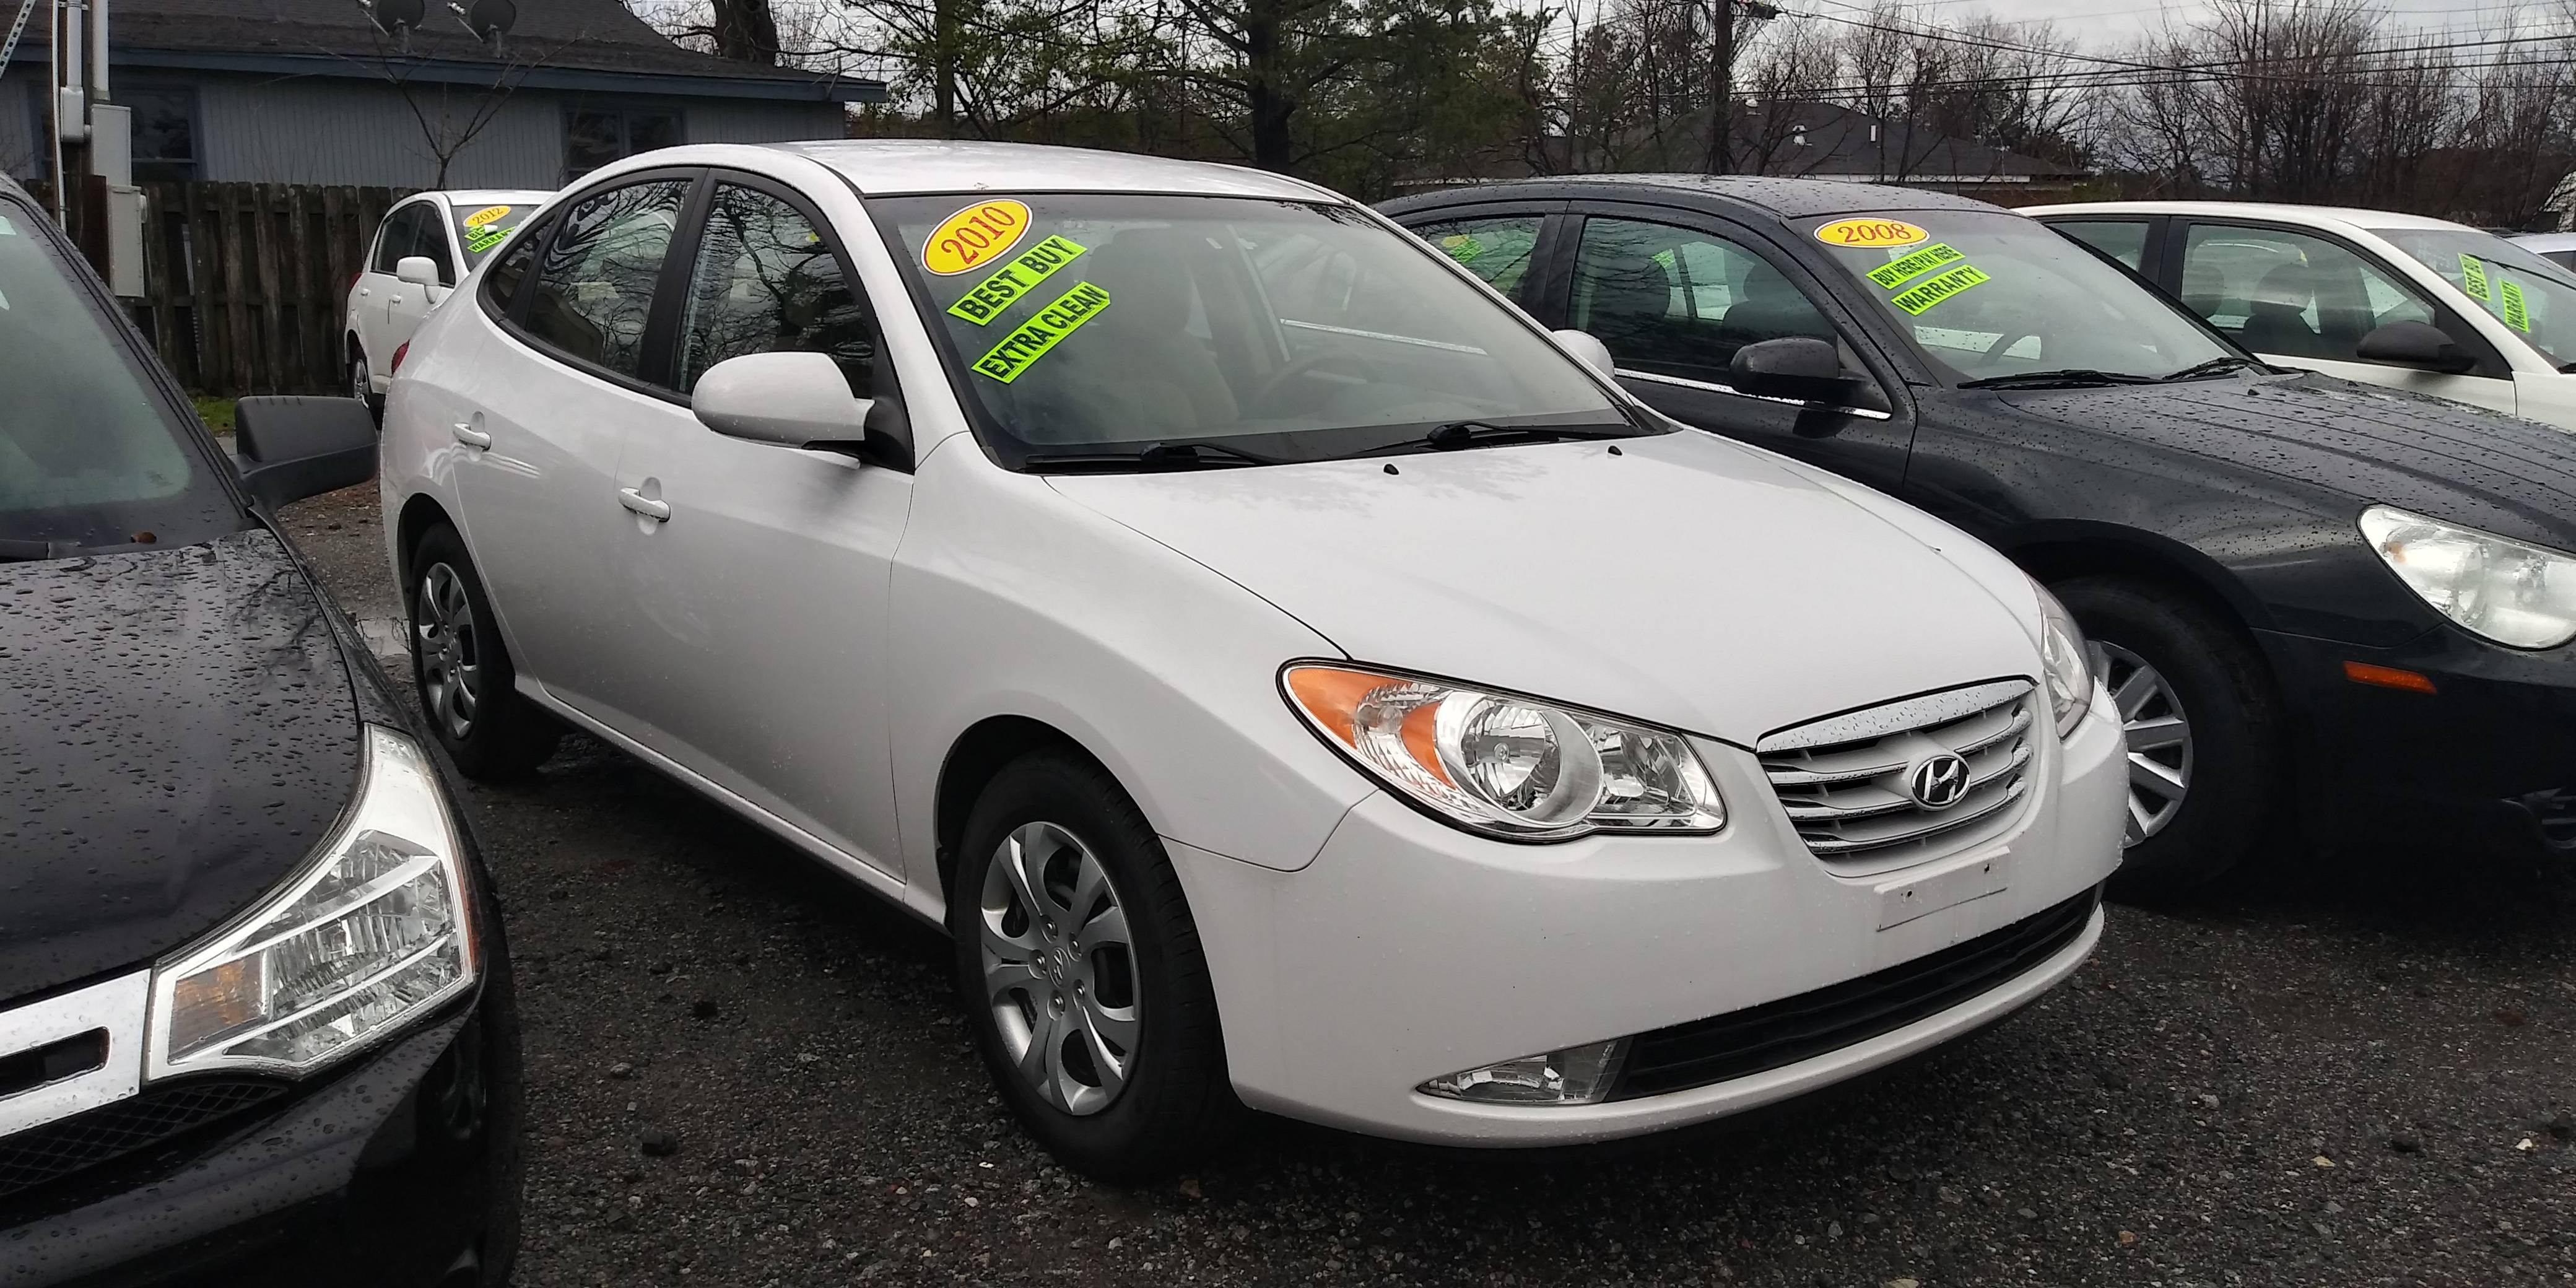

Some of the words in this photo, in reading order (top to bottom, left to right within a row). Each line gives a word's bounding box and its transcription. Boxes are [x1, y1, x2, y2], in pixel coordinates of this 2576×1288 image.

[472, 207, 503, 224] 2012
[941, 206, 1016, 265] 2010
[1837, 223, 1912, 243] 2008
[956, 269, 1029, 320] BEST
[1018, 238, 1076, 275] BUY
[1872, 268, 1901, 286] BUY
[1931, 246, 1960, 261] HERE
[2466, 271, 2487, 298] BEST
[1895, 267, 1984, 311] WARRANTY
[978, 324, 1058, 378] EXTRA
[1040, 285, 1109, 330] CLEAN
